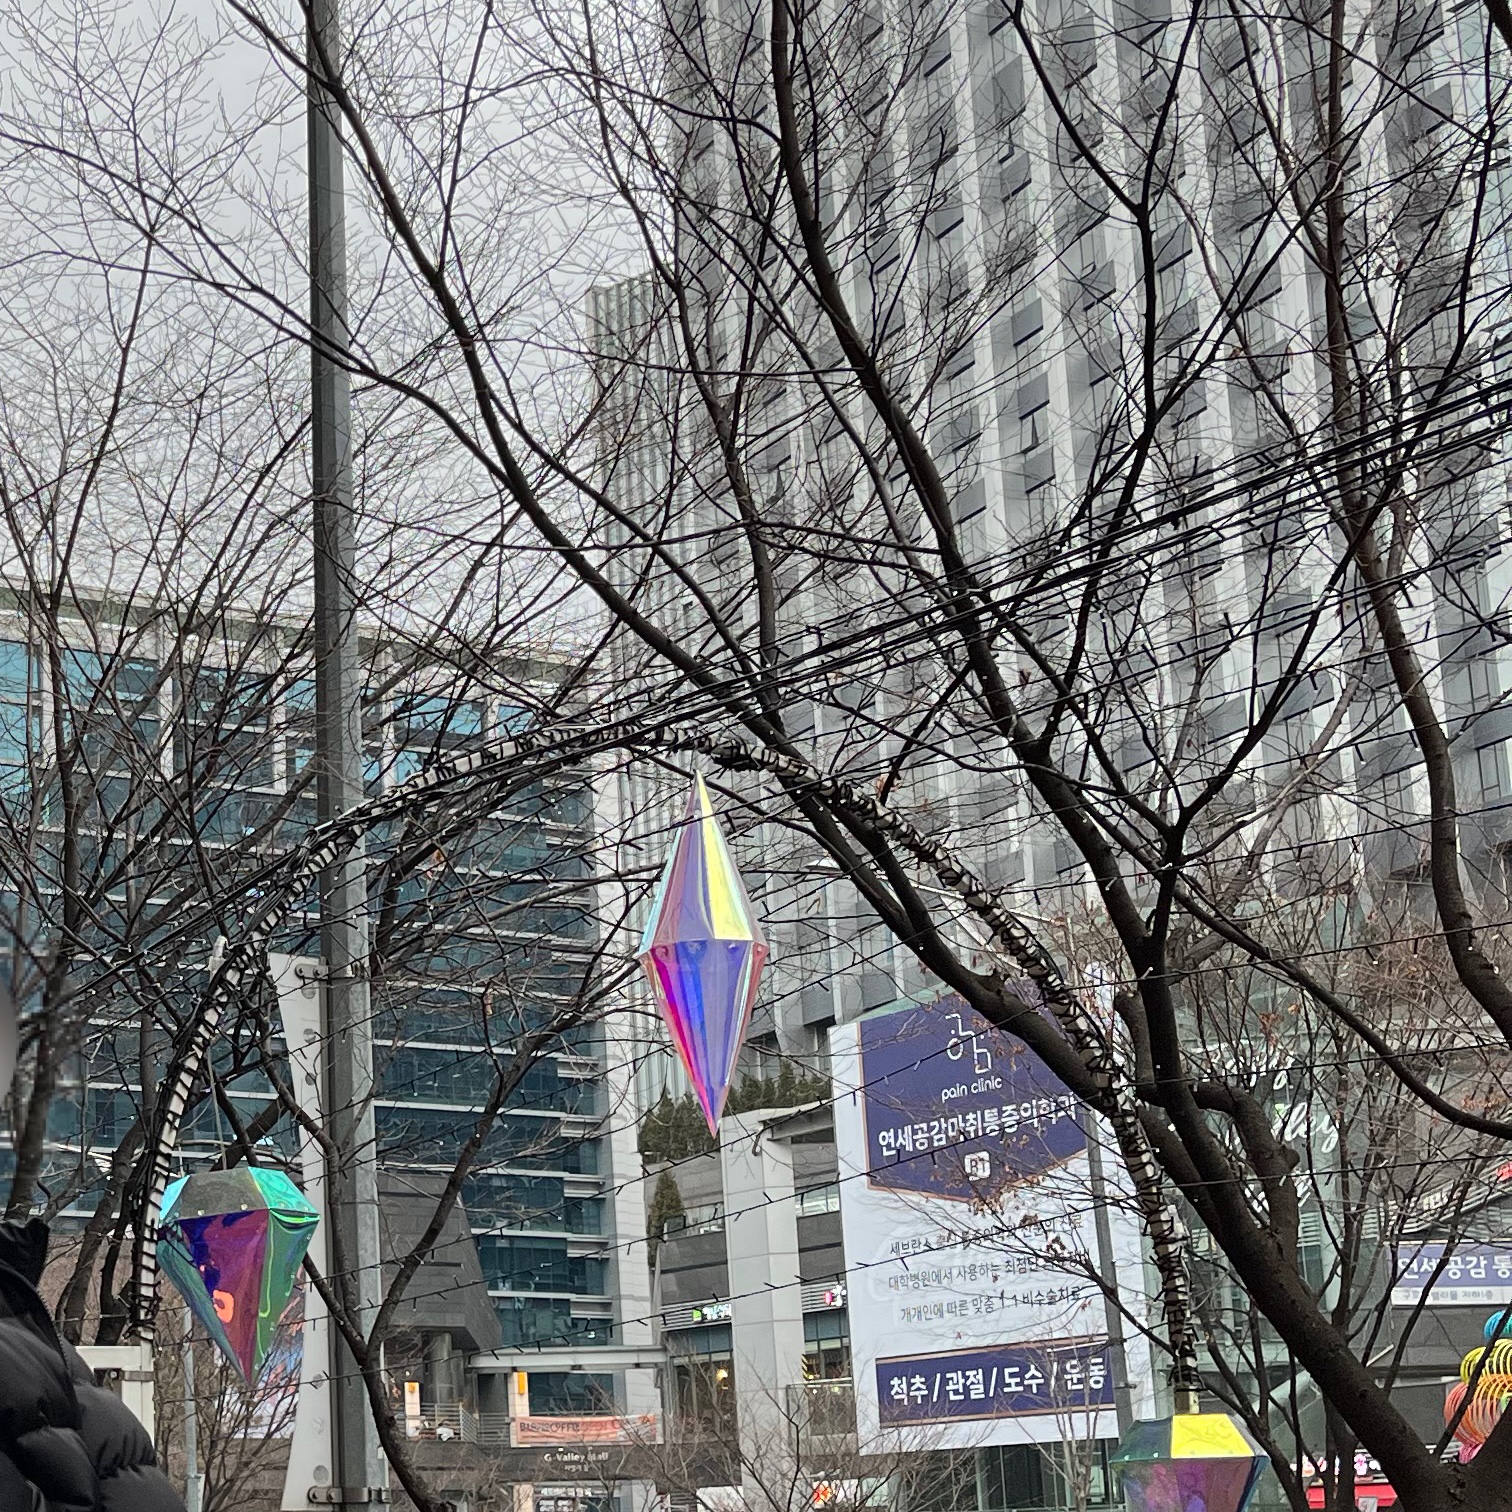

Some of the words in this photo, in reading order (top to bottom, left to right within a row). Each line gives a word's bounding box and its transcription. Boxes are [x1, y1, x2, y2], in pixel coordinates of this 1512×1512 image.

[941, 1083, 968, 1103] pain
[970, 1075, 1003, 1096] clinic
[888, 1266, 954, 1291] 대학병원에서
[956, 1262, 1001, 1285] 사용하는
[900, 1300, 945, 1323] 개개인에
[946, 1299, 970, 1317] 따른
[972, 1296, 995, 1314] 맞춤
[1021, 1286, 1083, 1308] 비수술치료
[889, 1374, 929, 1406] 척추
[945, 1368, 986, 1401] 관절
[1002, 1364, 1045, 1394] 도수
[1063, 1357, 1107, 1391] 운동
